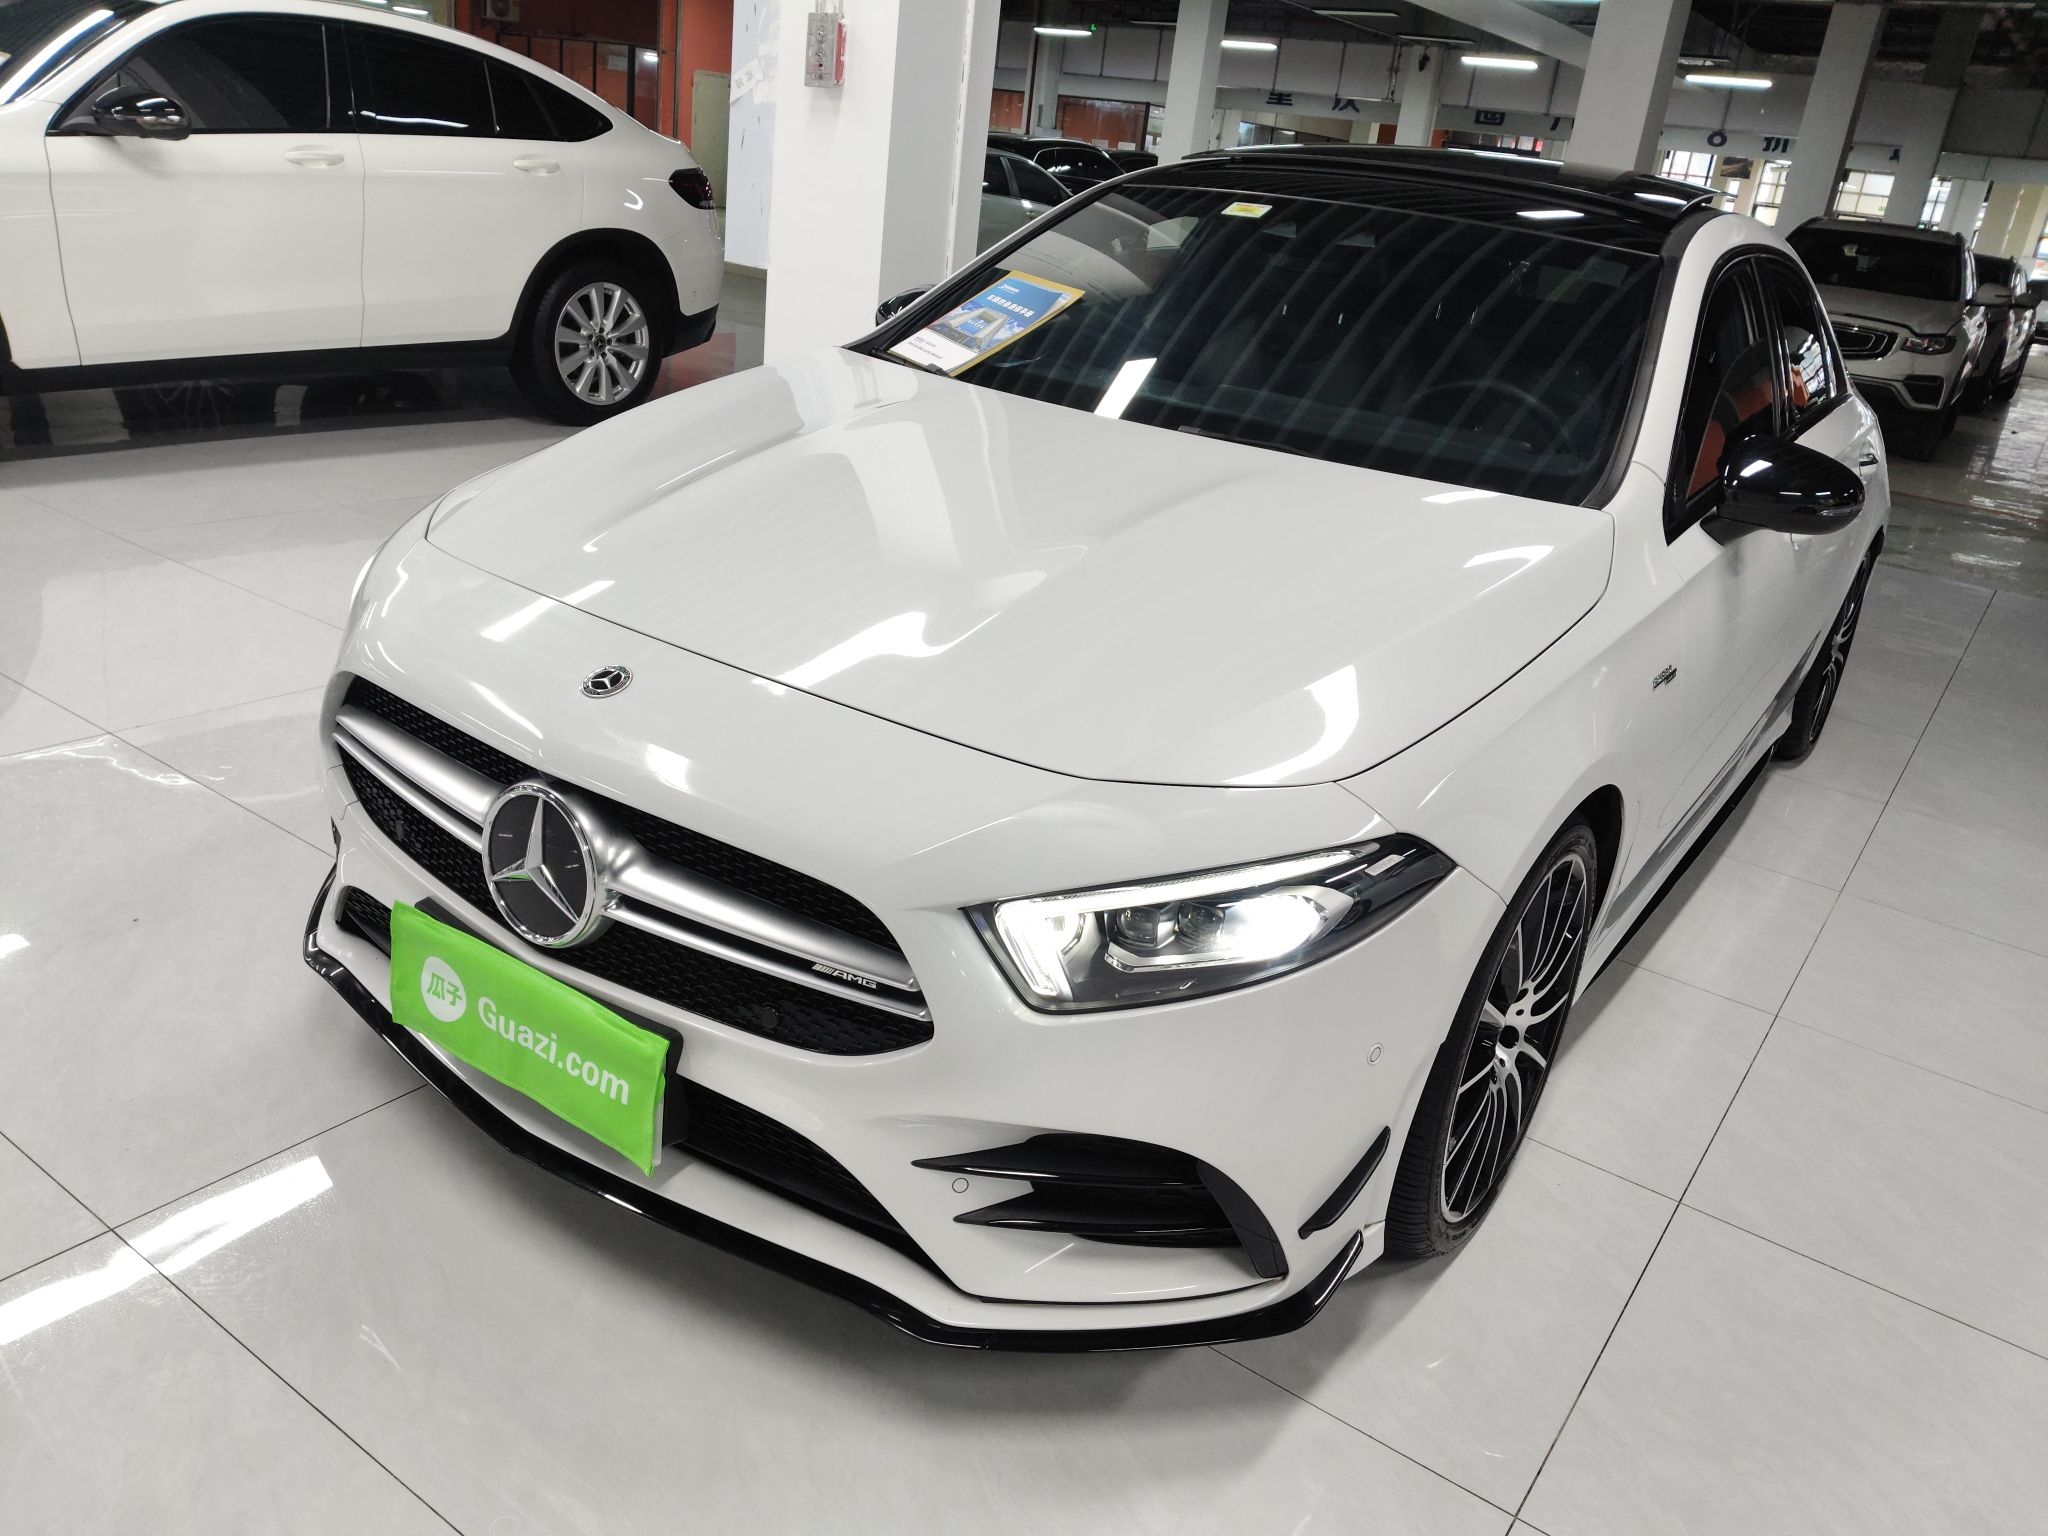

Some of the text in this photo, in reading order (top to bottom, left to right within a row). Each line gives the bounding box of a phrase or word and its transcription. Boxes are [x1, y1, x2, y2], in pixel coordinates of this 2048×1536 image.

[427, 972, 463, 1007] 瓜子
[832, 968, 877, 989] AMG
[478, 996, 629, 1105] Guazi.com
